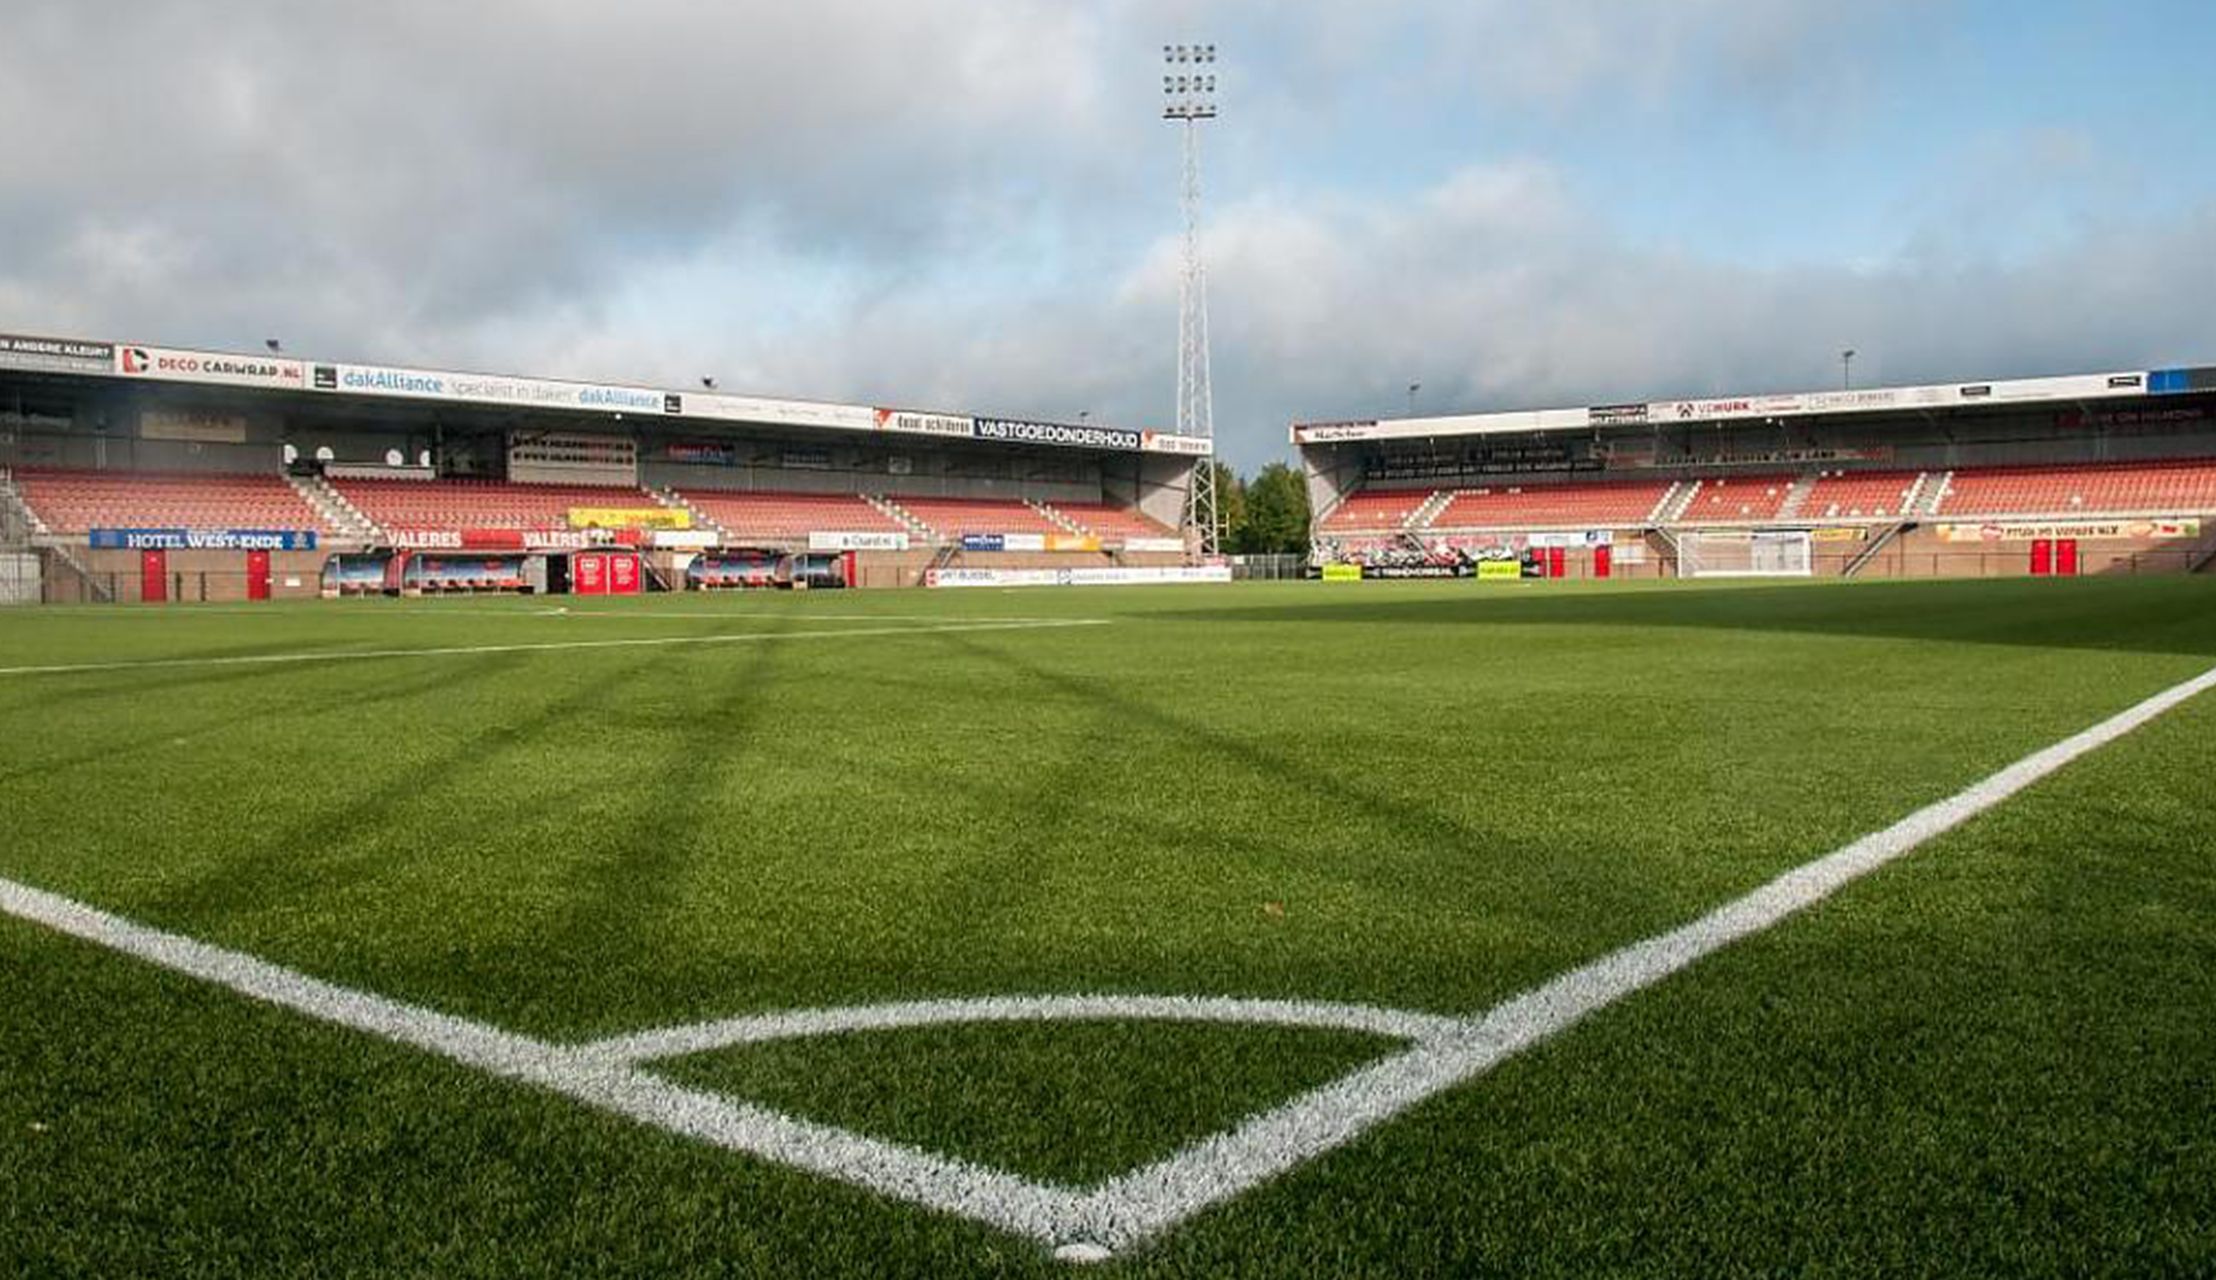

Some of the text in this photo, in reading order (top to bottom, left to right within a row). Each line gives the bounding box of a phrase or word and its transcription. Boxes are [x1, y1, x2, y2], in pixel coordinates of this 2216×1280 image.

[158, 356, 198, 372] DECO
[343, 372, 444, 393] dakAlliance
[978, 420, 1138, 449] VASTGOEDONDERHOUD
[127, 534, 283, 548] HOTEL WEST-ENDE
[387, 531, 463, 547] VALERES
